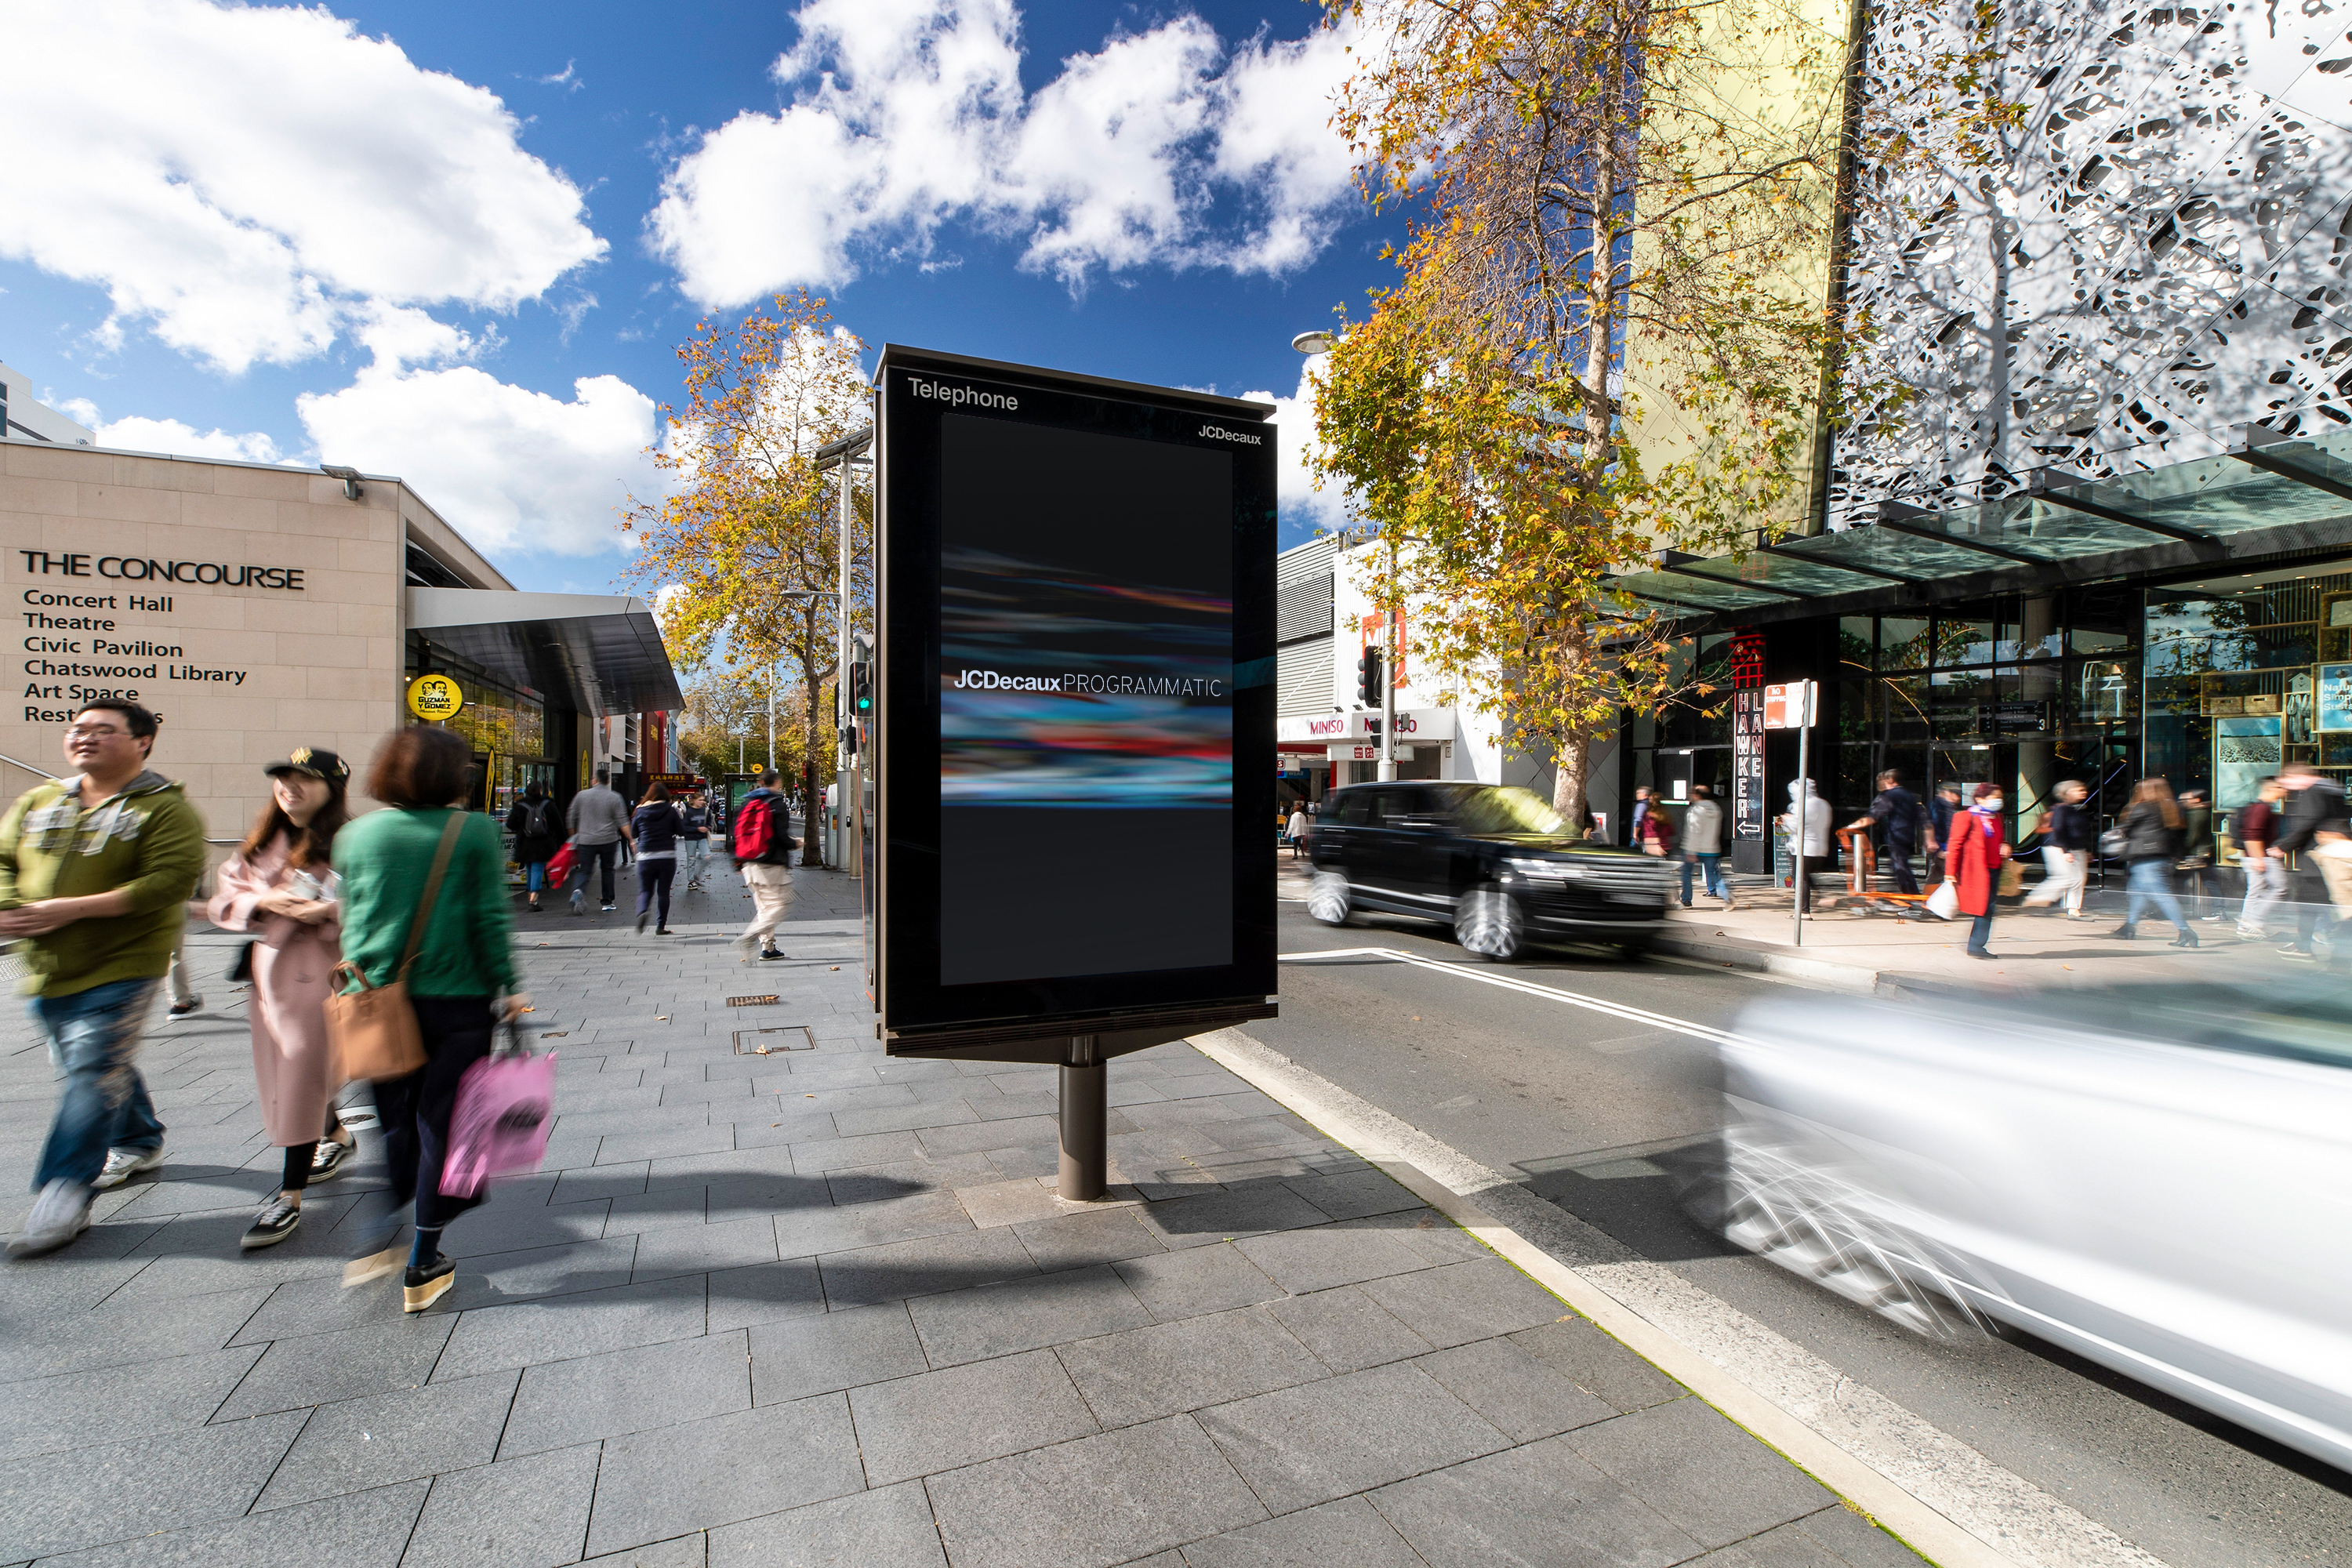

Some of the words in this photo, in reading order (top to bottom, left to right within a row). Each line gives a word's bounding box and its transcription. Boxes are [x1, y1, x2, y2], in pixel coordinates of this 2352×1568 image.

[908, 377, 1018, 412] Telephone
[1198, 425, 1261, 446] JCDecaux
[20, 550, 91, 577] THE
[97, 556, 304, 590] CONCOURSE
[24, 590, 117, 609] Concert
[129, 595, 172, 612] Hall
[23, 612, 115, 631] Theatre
[24, 637, 81, 653] Civic
[93, 639, 183, 657] Pavilion
[24, 659, 157, 678] Chatswood
[169, 665, 247, 685] Library
[24, 683, 62, 699] Art
[69, 684, 140, 702] Space
[954, 670, 1062, 691] JCDecaux
[1064, 673, 1221, 697] PROGRAMMATIC
[1310, 720, 1344, 735] MINISO
[1752, 692, 1762, 777] LANE
[2038, 719, 2045, 731] 3
[1737, 693, 1749, 818] HAWKER
